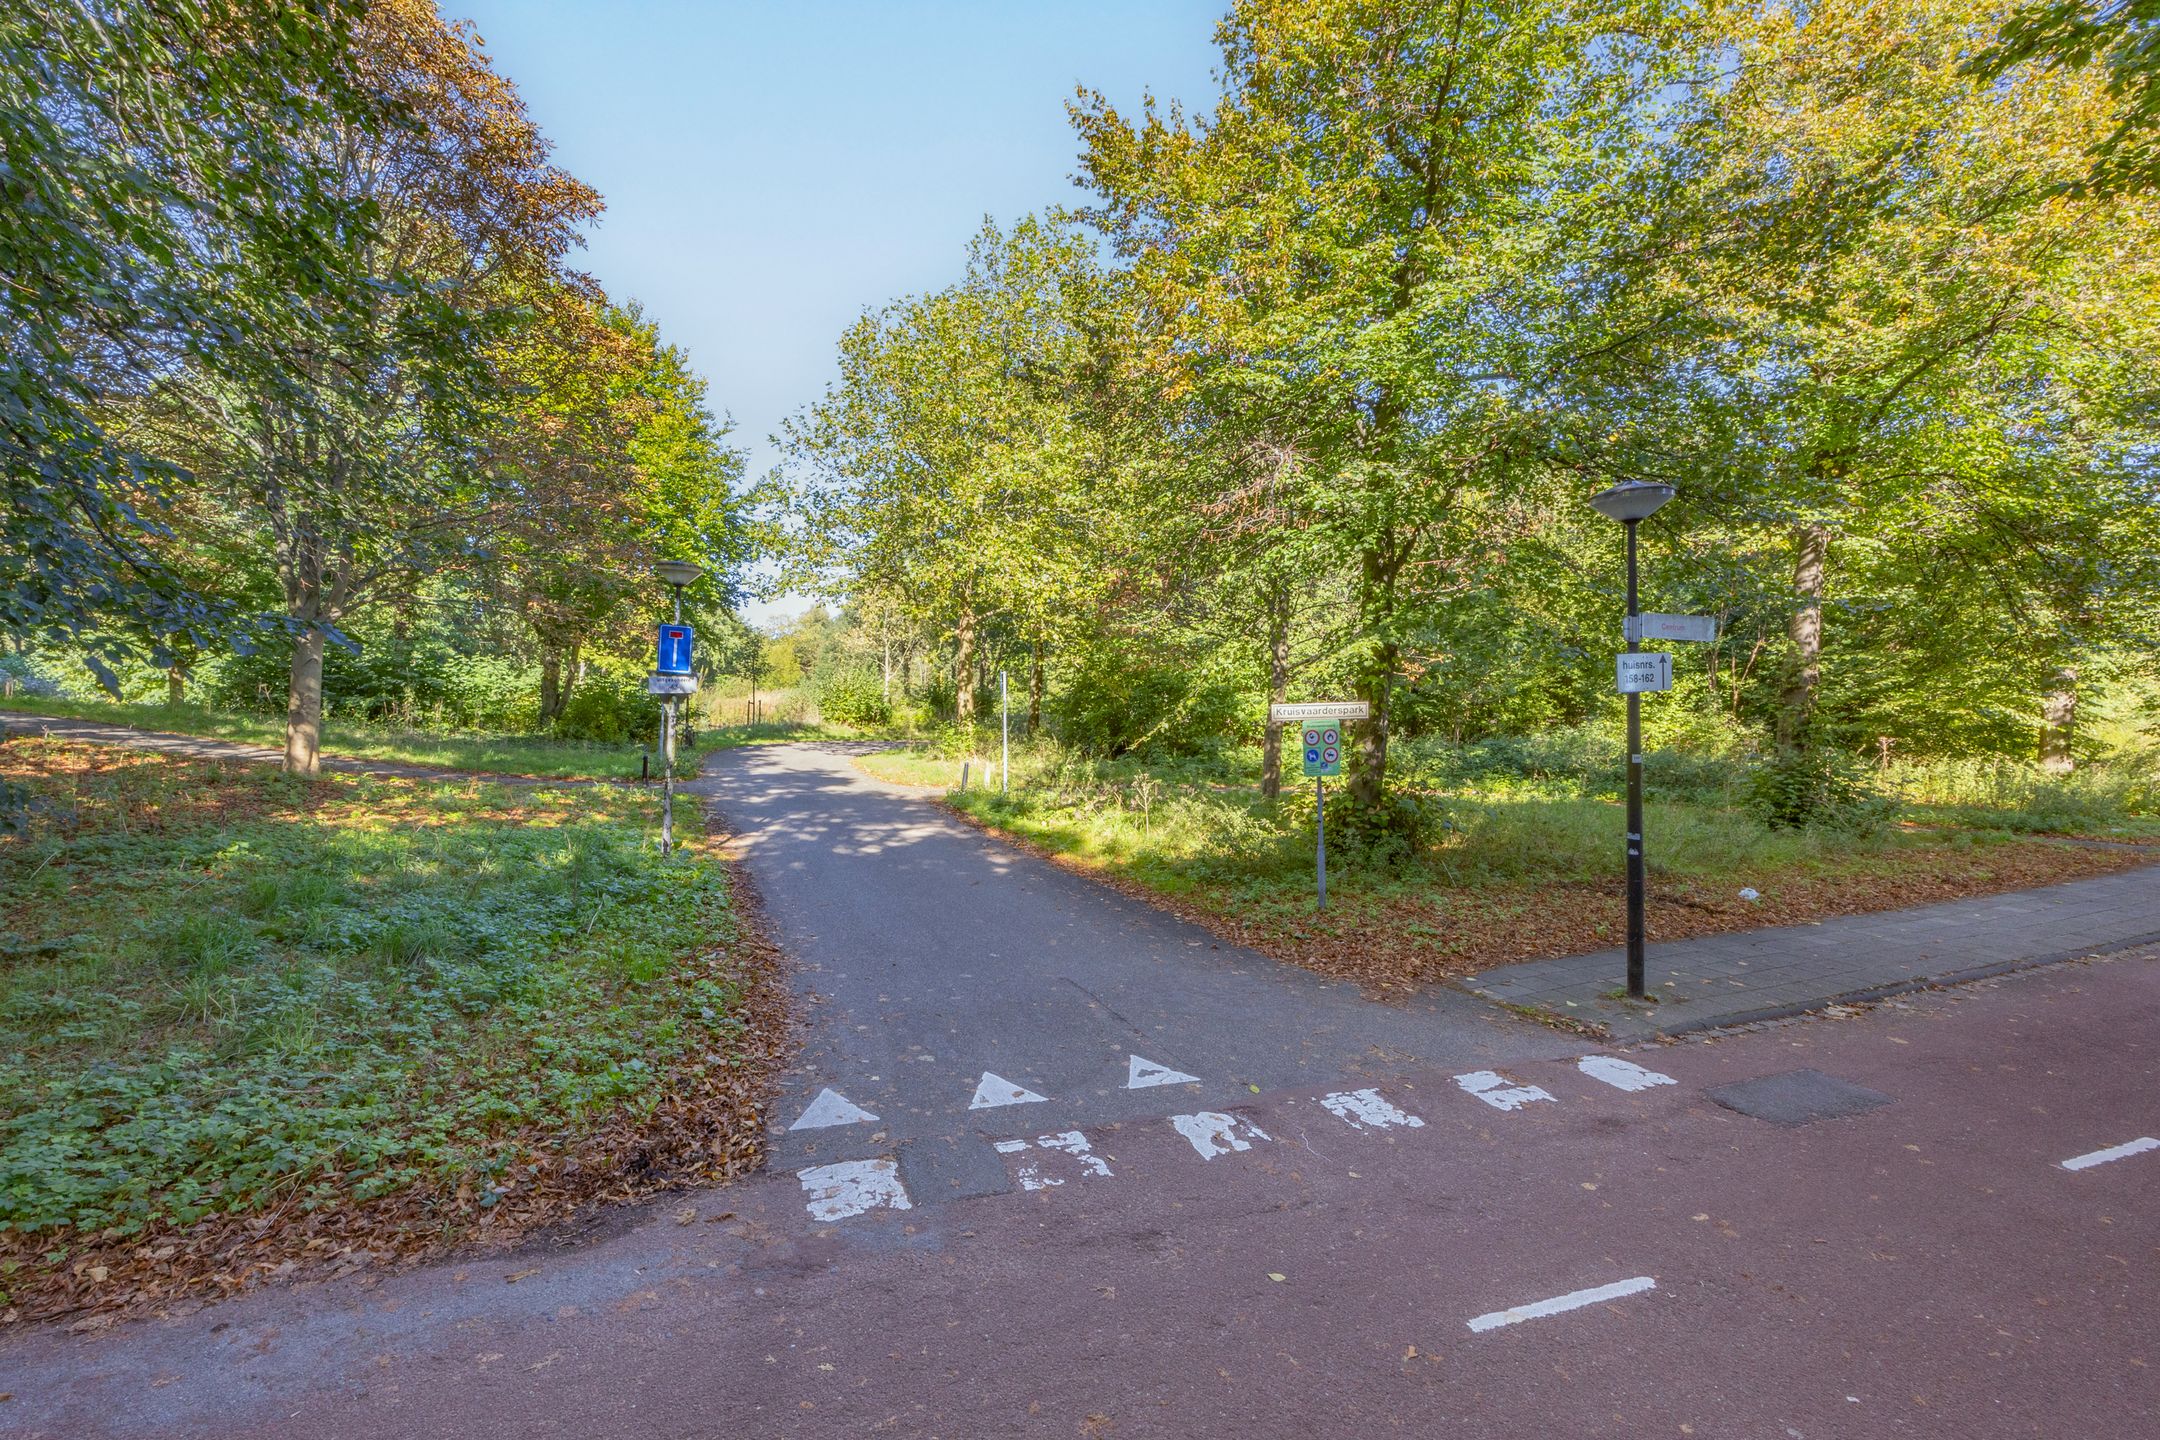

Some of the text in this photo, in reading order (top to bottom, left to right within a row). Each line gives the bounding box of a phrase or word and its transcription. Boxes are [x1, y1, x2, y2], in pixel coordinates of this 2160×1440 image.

[1661, 623, 1686, 631] Centrum
[1622, 660, 1656, 670] huisnrs.
[1624, 673, 1655, 684] 158-162
[1276, 706, 1364, 717] Kruisvaarderspark
